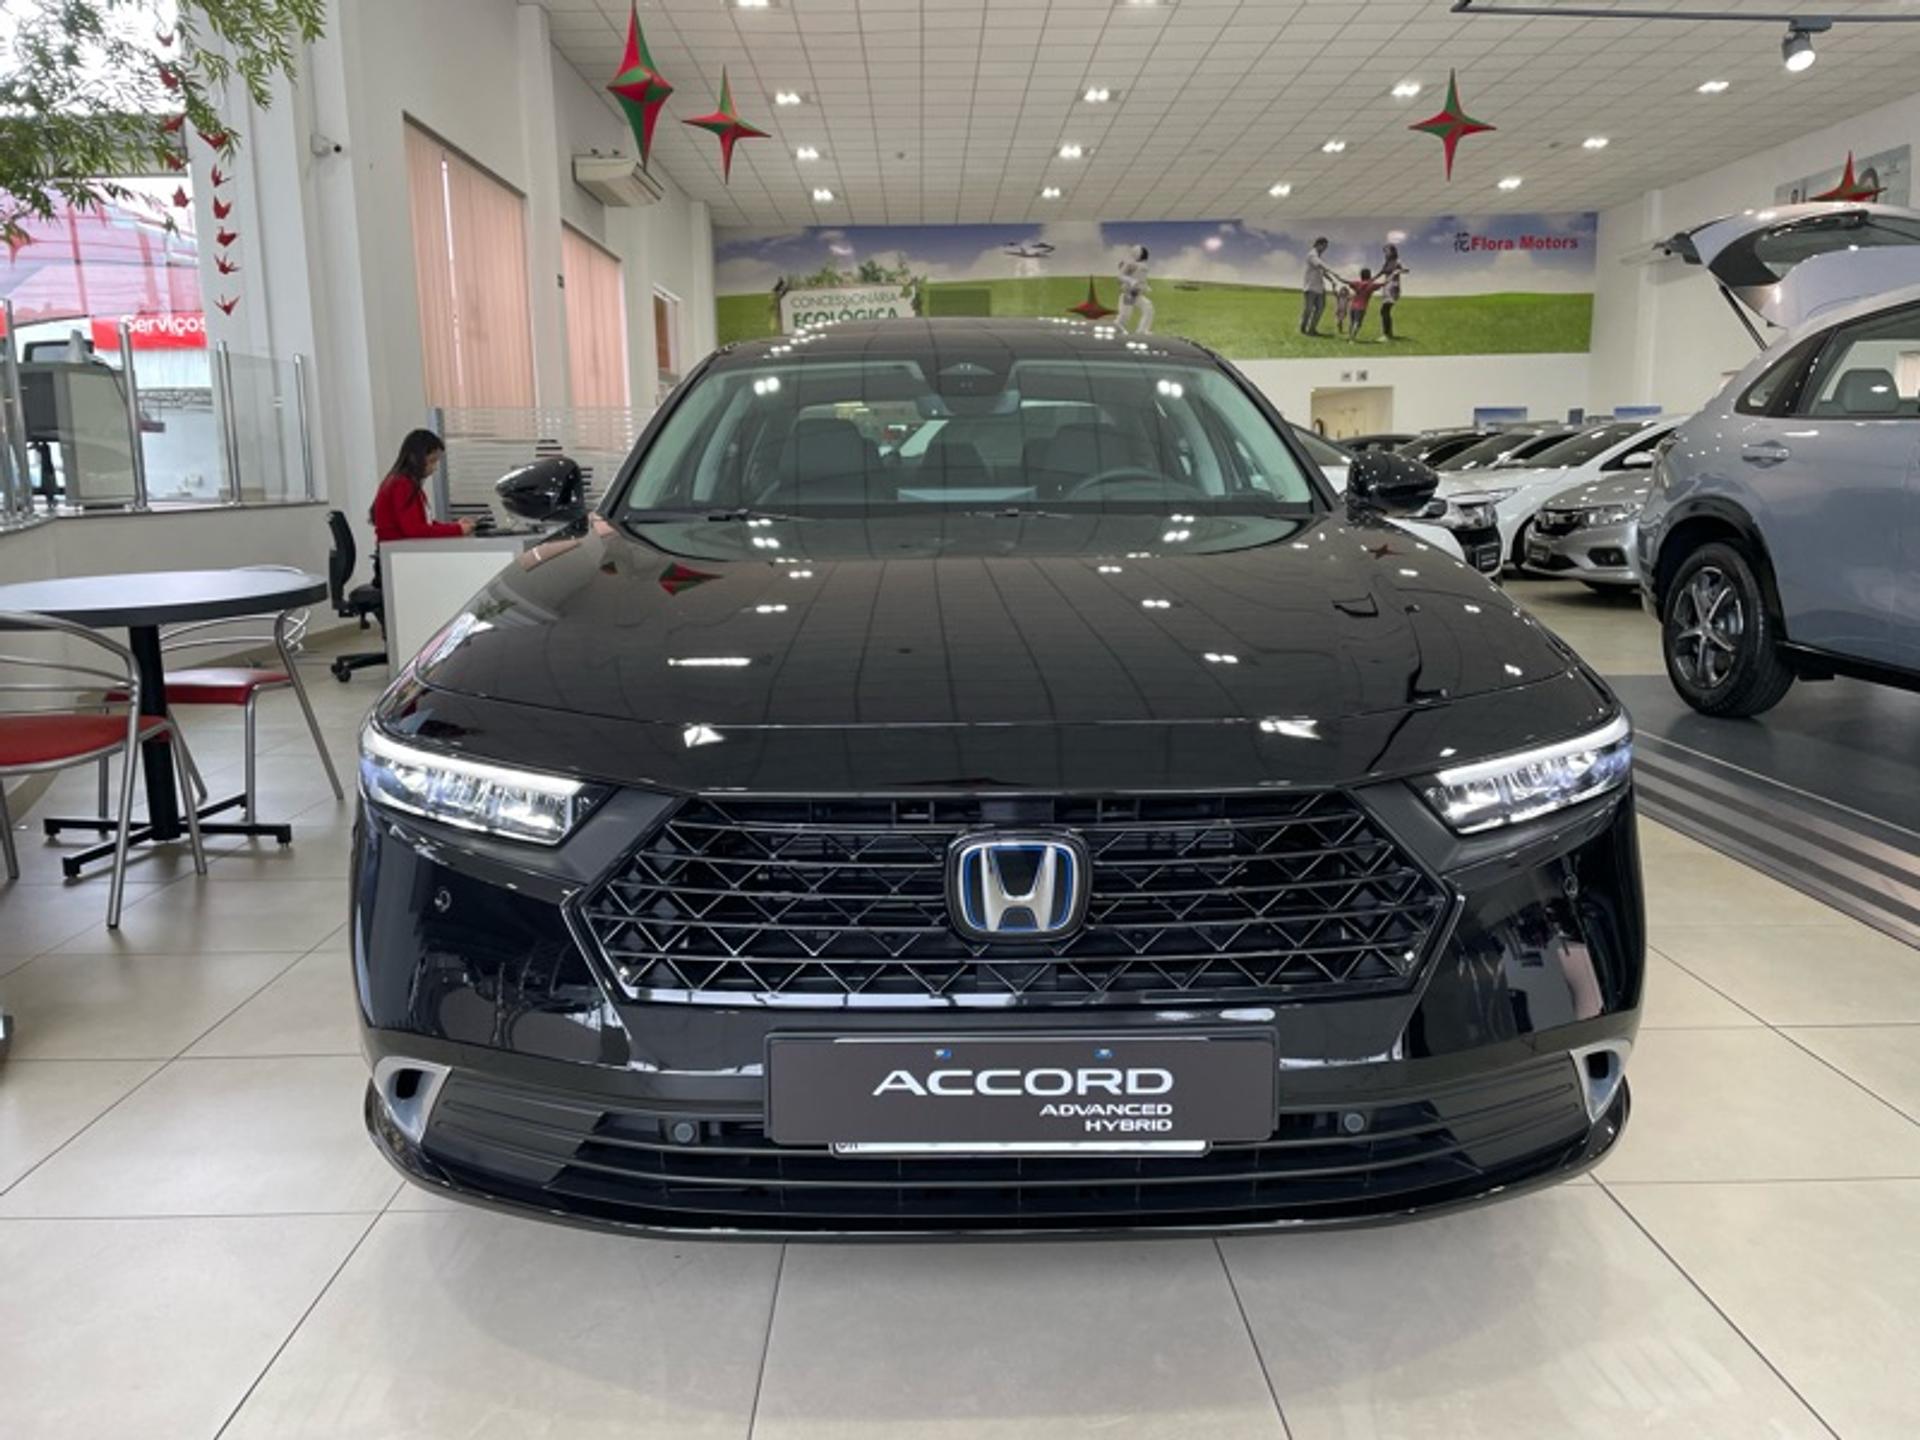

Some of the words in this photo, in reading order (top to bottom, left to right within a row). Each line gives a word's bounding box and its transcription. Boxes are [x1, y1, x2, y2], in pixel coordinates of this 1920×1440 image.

[1471, 236, 1514, 250] Flora
[1520, 235, 1578, 250] Motors
[872, 1068, 1174, 1096] ACCORD
[1039, 1103, 1173, 1117] ADVANCED
[1085, 1119, 1173, 1132] HYBRID
